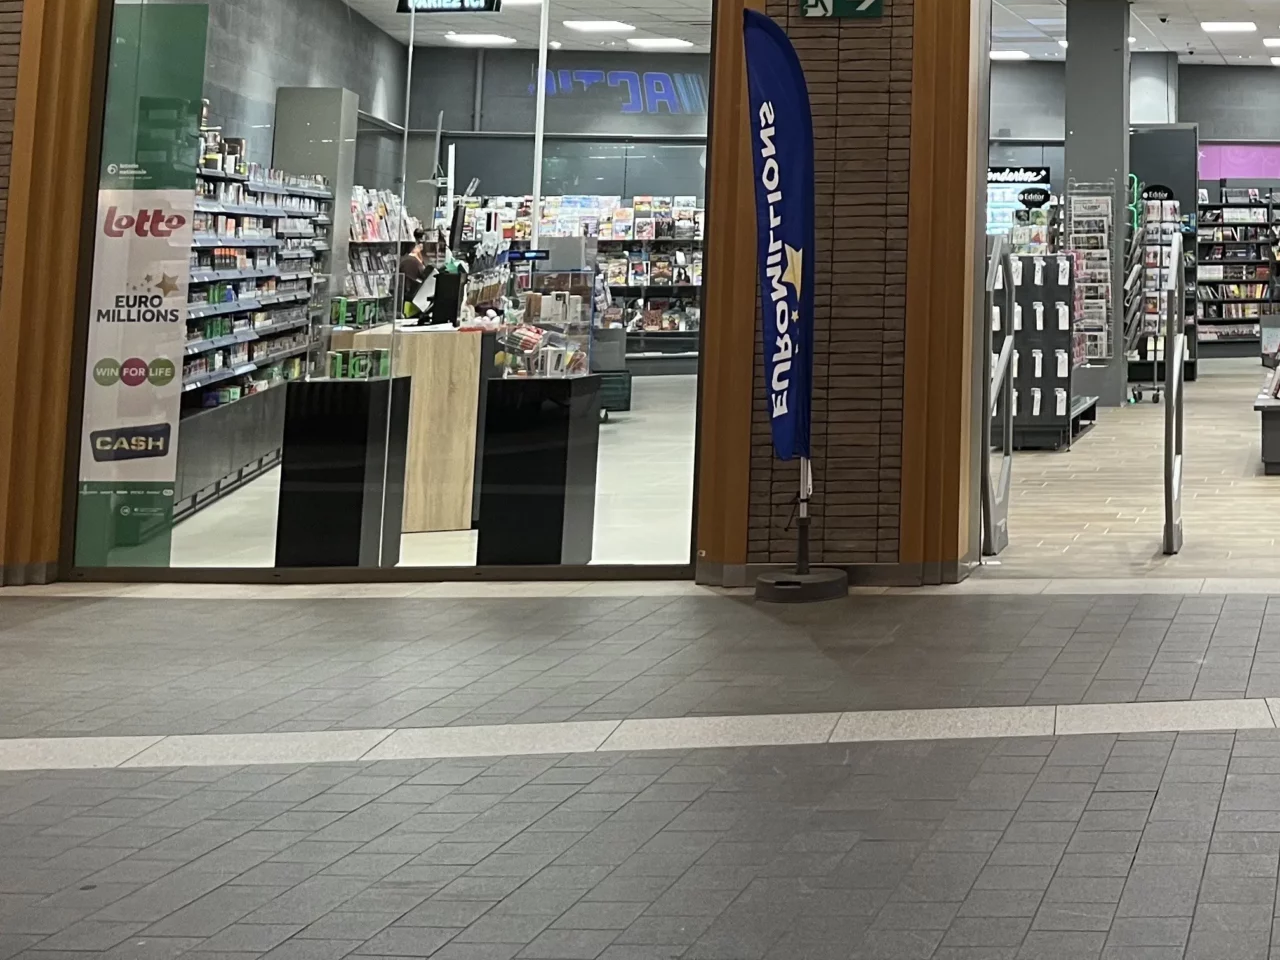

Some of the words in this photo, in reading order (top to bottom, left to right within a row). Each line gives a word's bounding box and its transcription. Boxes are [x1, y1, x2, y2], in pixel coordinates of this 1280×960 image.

[115, 295, 163, 309] EURO
[96, 308, 180, 324] MILLIONS
[96, 366, 119, 377] WIN
[123, 366, 146, 377] FOR
[149, 366, 174, 377] LIFE
